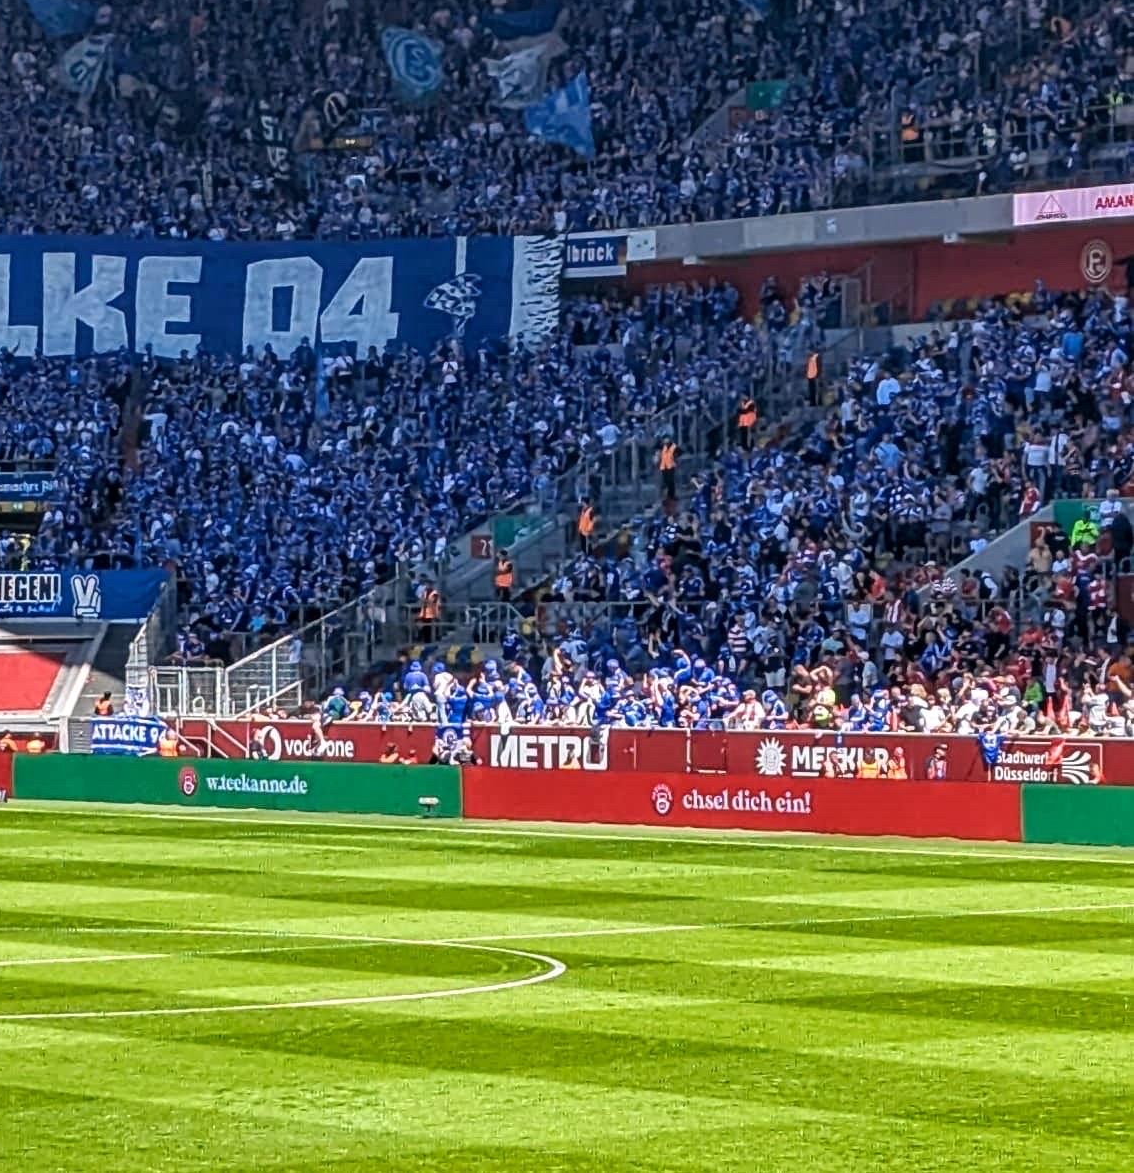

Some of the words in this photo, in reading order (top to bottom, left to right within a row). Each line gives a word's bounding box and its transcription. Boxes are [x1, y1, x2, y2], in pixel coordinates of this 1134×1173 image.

[242, 255, 400, 362] 04
[92, 724, 147, 742] ATTACKE
[284, 734, 354, 757] vodone
[994, 765, 1058, 782] Düsseldorf
[683, 789, 729, 810] chsel
[732, 789, 772, 812] dich
[776, 791, 811, 814] ein!
